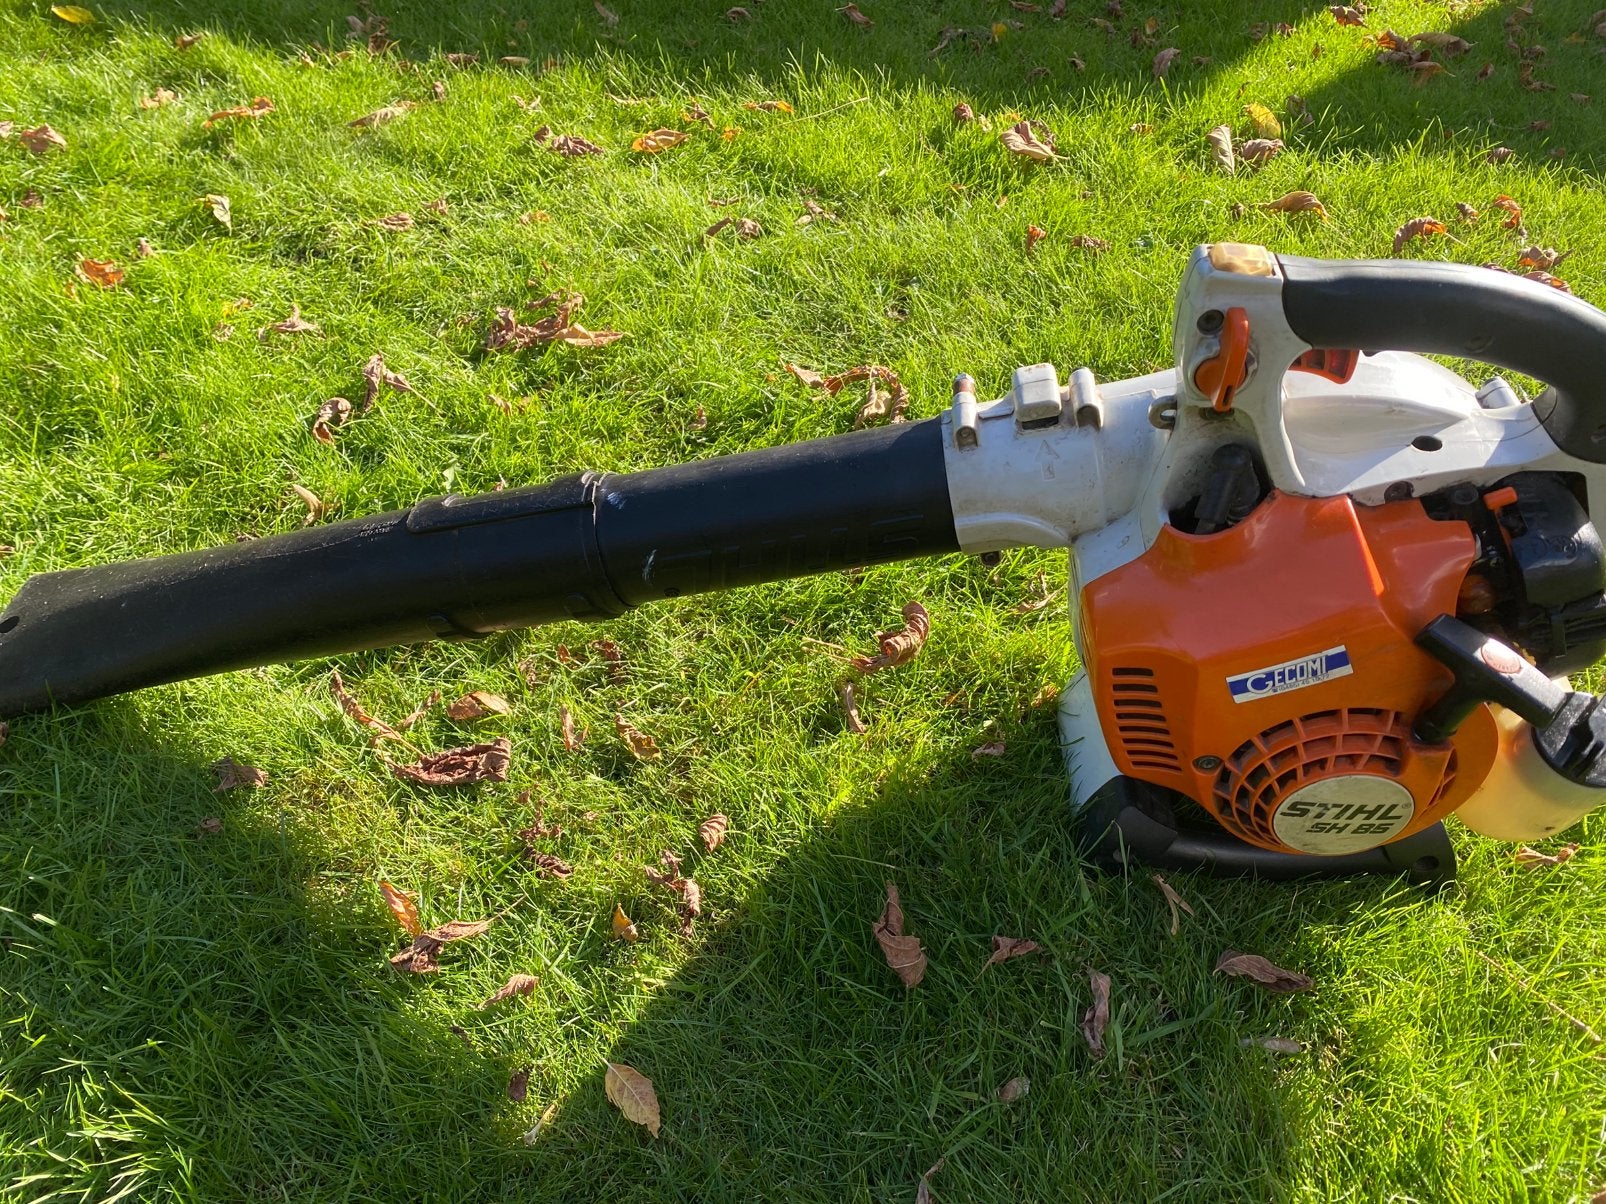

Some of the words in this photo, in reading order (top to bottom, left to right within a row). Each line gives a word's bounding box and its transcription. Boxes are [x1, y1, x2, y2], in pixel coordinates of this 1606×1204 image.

[1246, 655, 1328, 694] GECOMI
[1280, 801, 1403, 820] STIHL
[1306, 822, 1350, 834] SH
[1351, 823, 1394, 834] 85
